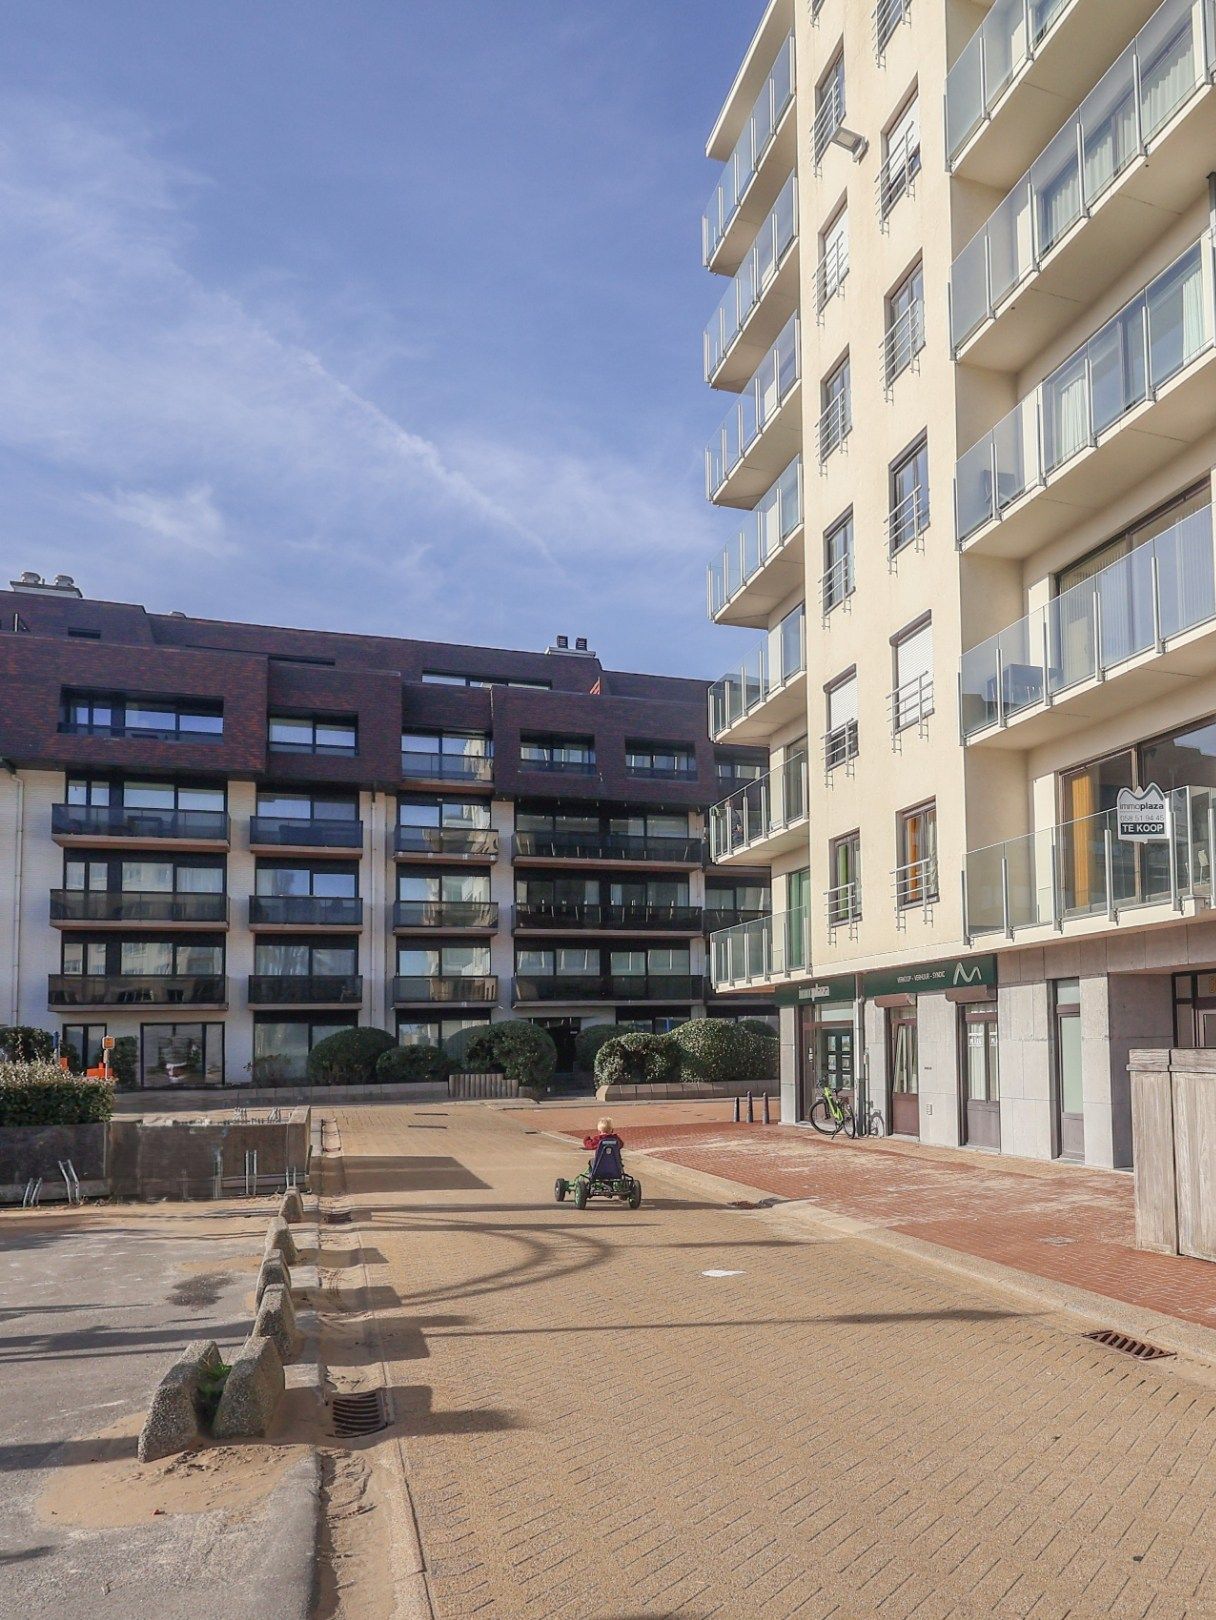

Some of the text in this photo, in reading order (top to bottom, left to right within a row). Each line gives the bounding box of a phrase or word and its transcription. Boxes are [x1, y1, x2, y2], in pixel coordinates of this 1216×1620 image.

[1120, 802, 1164, 811] immoplaza
[1122, 823, 1163, 832] TE KOOP
